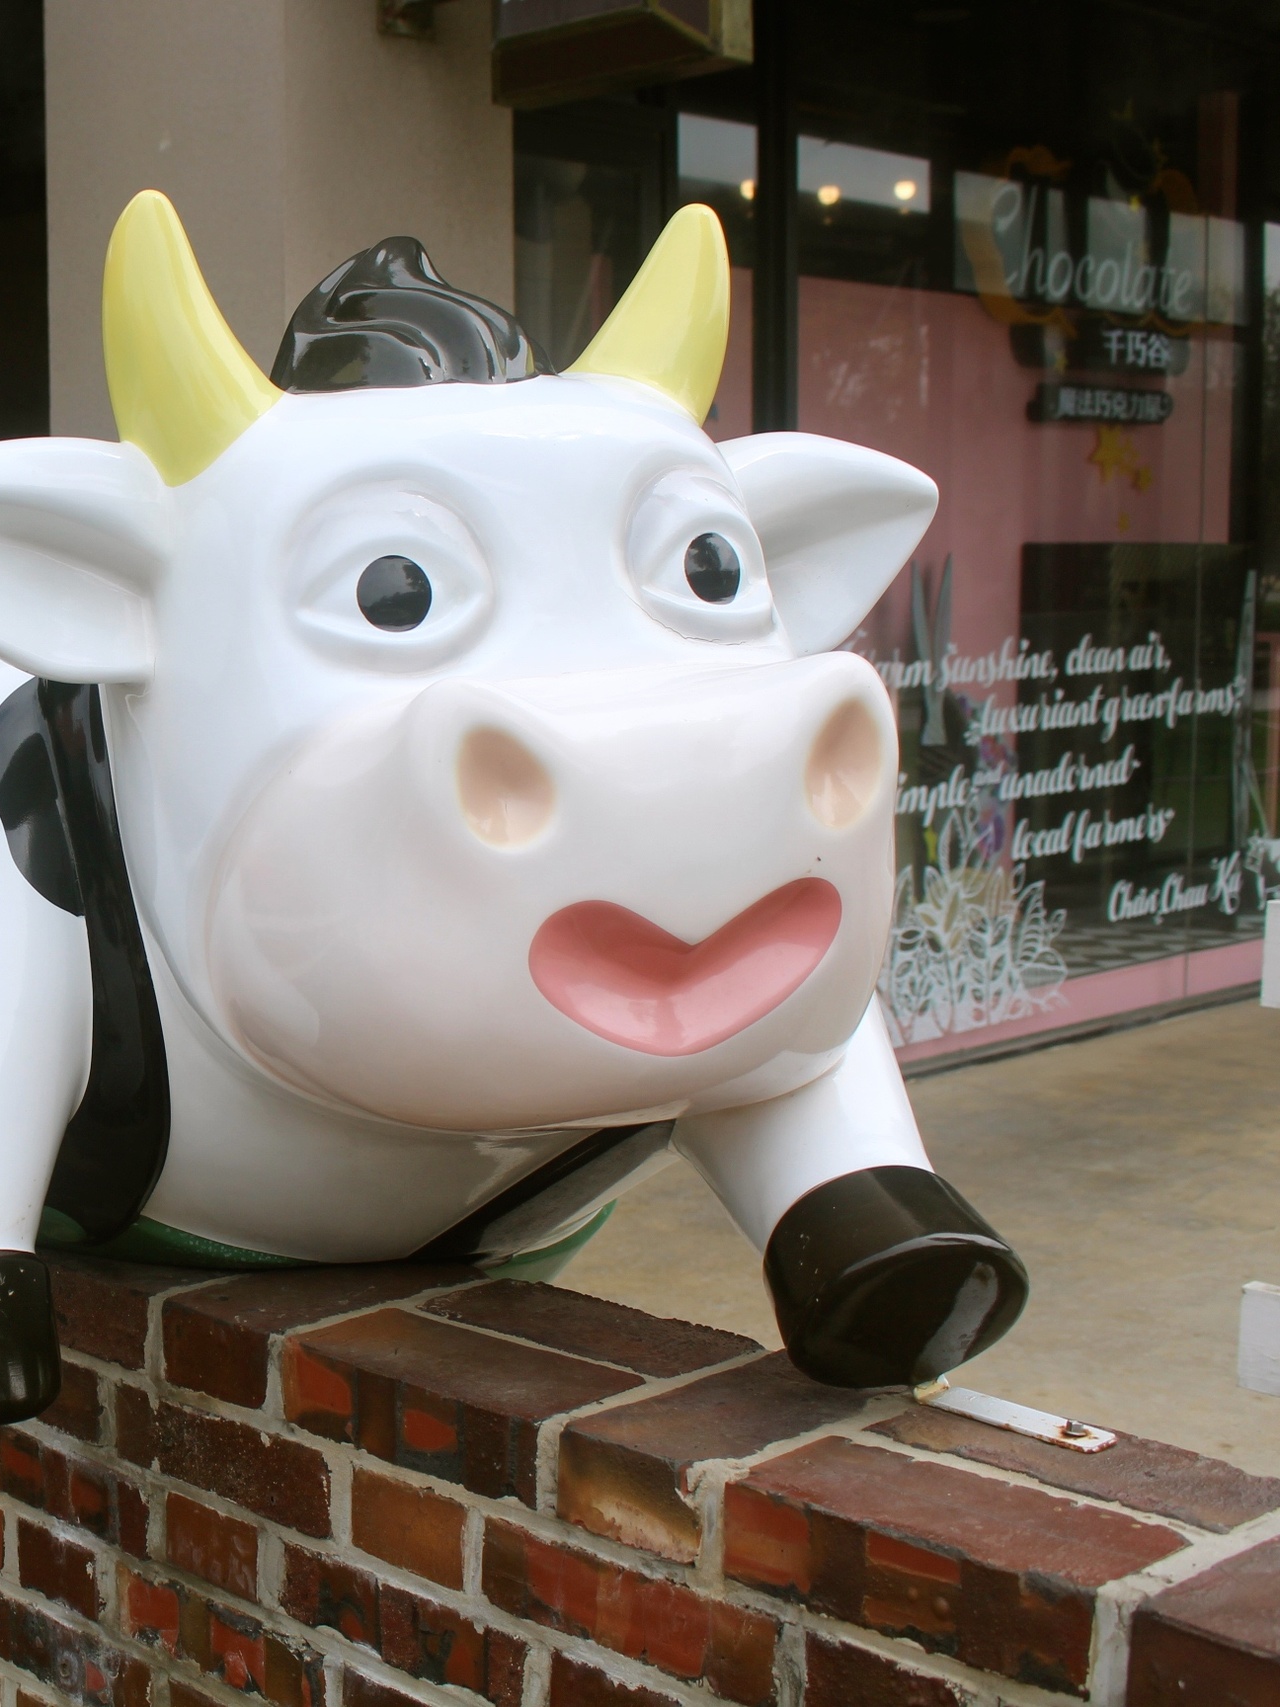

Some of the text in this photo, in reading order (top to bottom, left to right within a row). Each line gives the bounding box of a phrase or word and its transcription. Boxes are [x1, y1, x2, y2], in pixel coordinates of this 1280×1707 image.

[991, 184, 1194, 313] Chocolate
[1103, 328, 1170, 368] 千巧谷
[894, 763, 972, 827] imple
[999, 743, 1141, 801] unadorned
[1011, 810, 1076, 861] local
